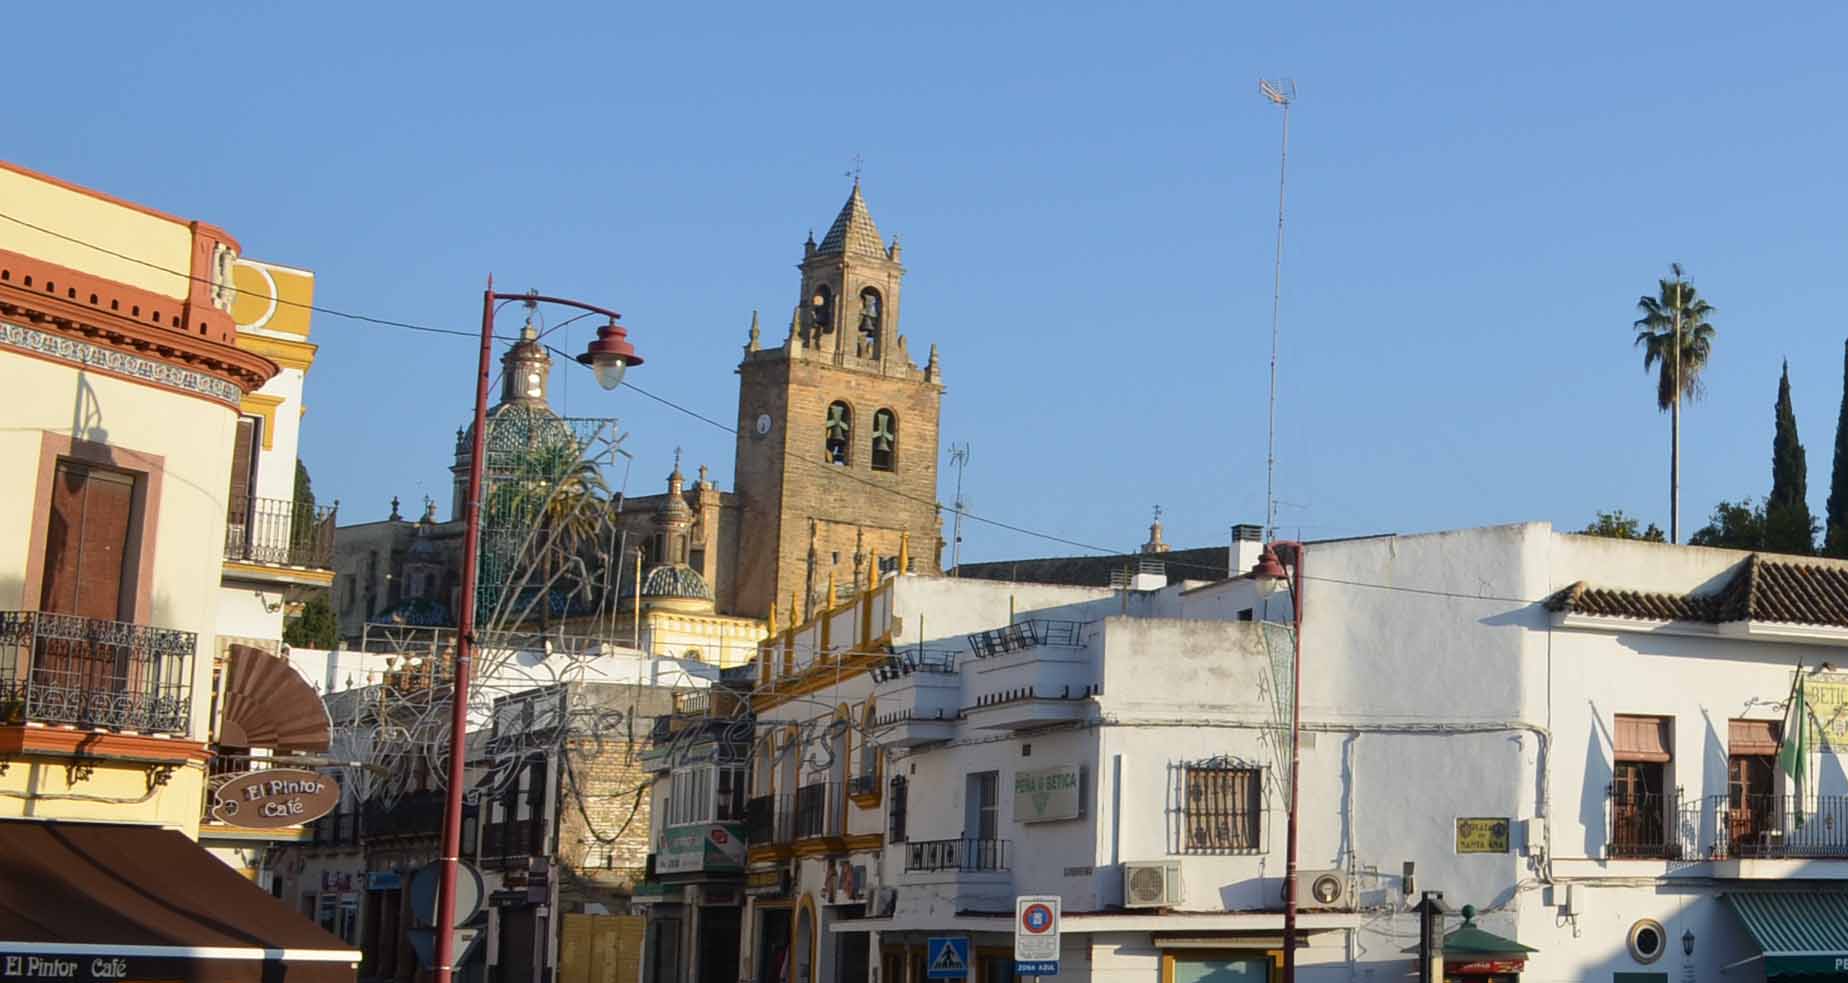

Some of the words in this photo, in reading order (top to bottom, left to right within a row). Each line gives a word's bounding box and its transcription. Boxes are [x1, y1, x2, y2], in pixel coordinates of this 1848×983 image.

[247, 784, 266, 801] El
[270, 779, 325, 794] Pintor
[263, 797, 304, 817] Café
[4, 956, 22, 976] El
[26, 956, 78, 977] Pintor
[91, 958, 127, 978] Café
